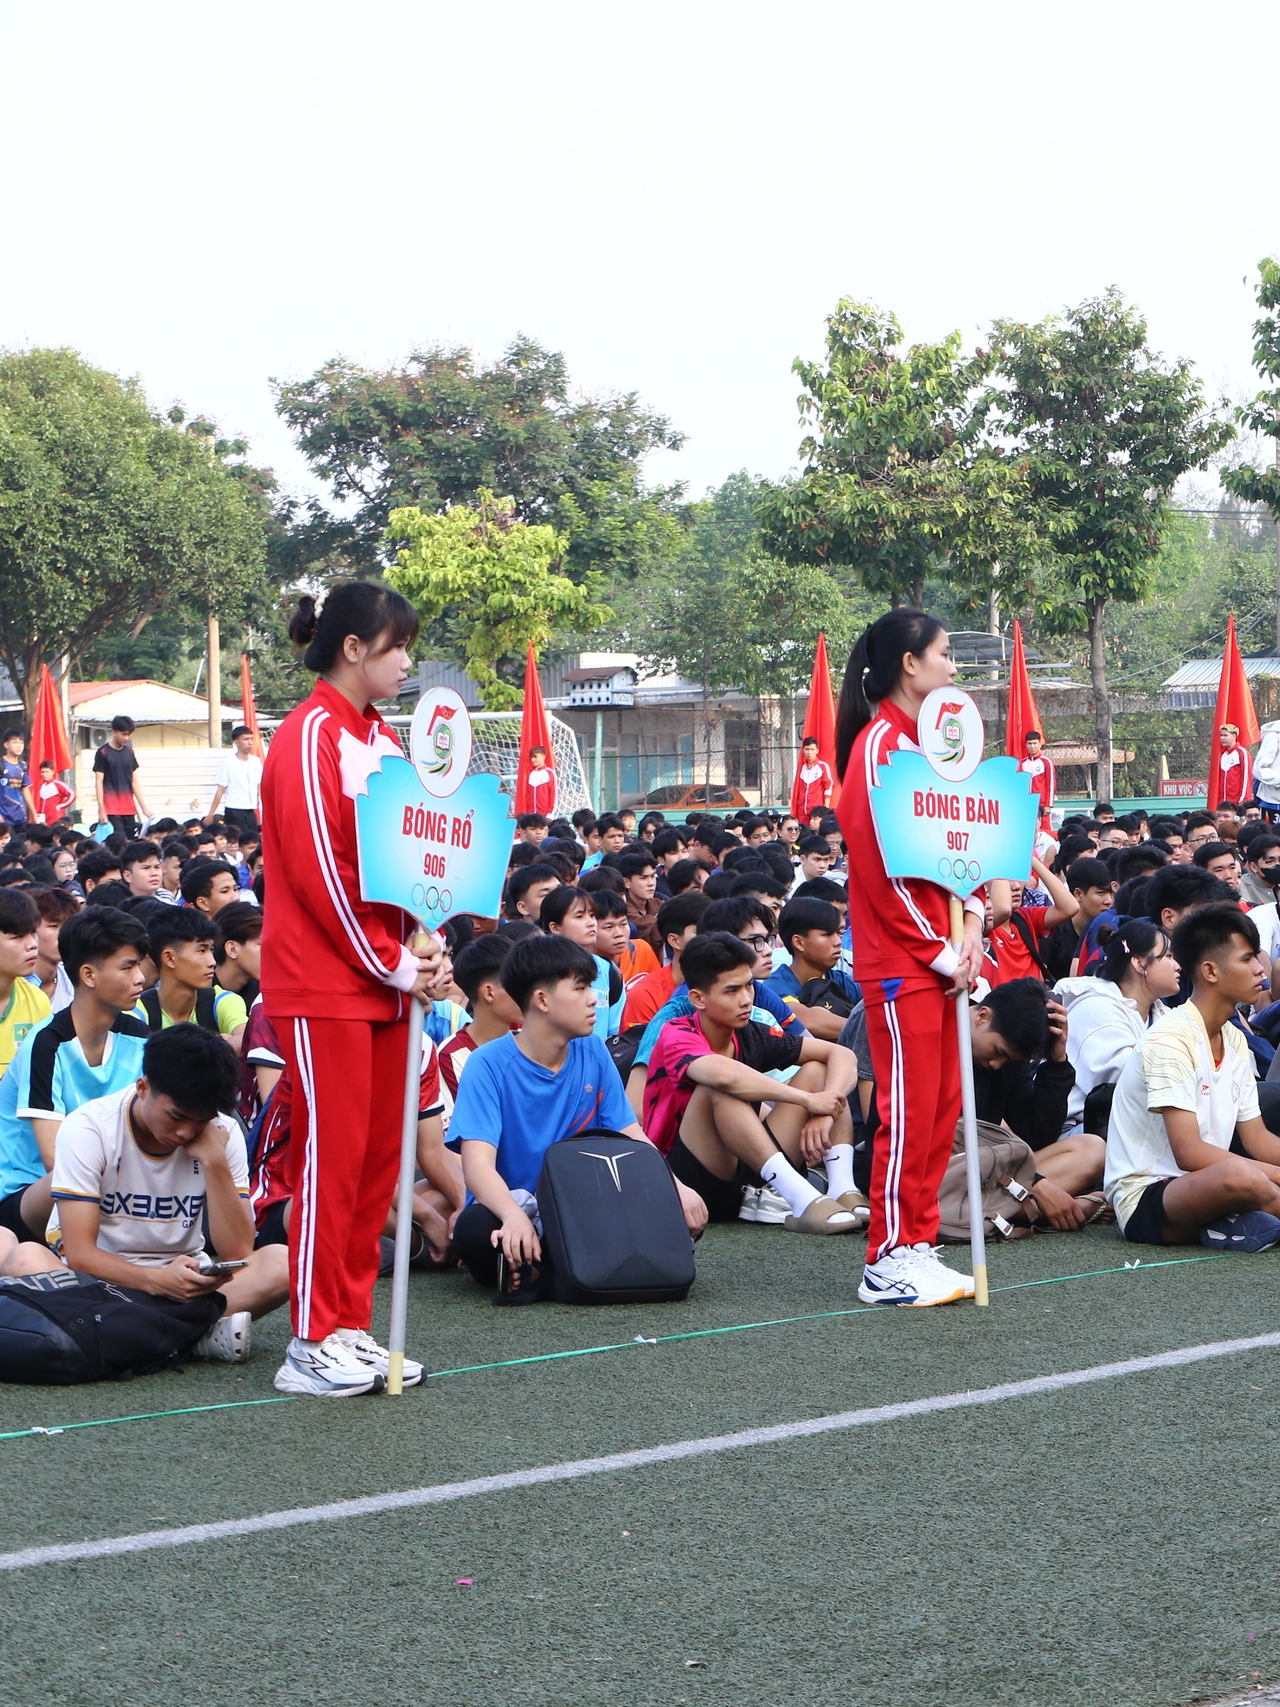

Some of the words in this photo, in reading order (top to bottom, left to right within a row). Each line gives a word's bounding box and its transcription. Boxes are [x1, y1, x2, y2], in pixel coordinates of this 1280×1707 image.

[1163, 784, 1177, 795] KHU
[1178, 783, 1193, 796] VỰC
[913, 786, 960, 821] BÓNG
[965, 792, 1000, 825] BÀN
[402, 801, 447, 844] BÓNG
[450, 808, 475, 850] RỔ
[947, 830, 969, 851] 907
[423, 852, 446, 878] 906
